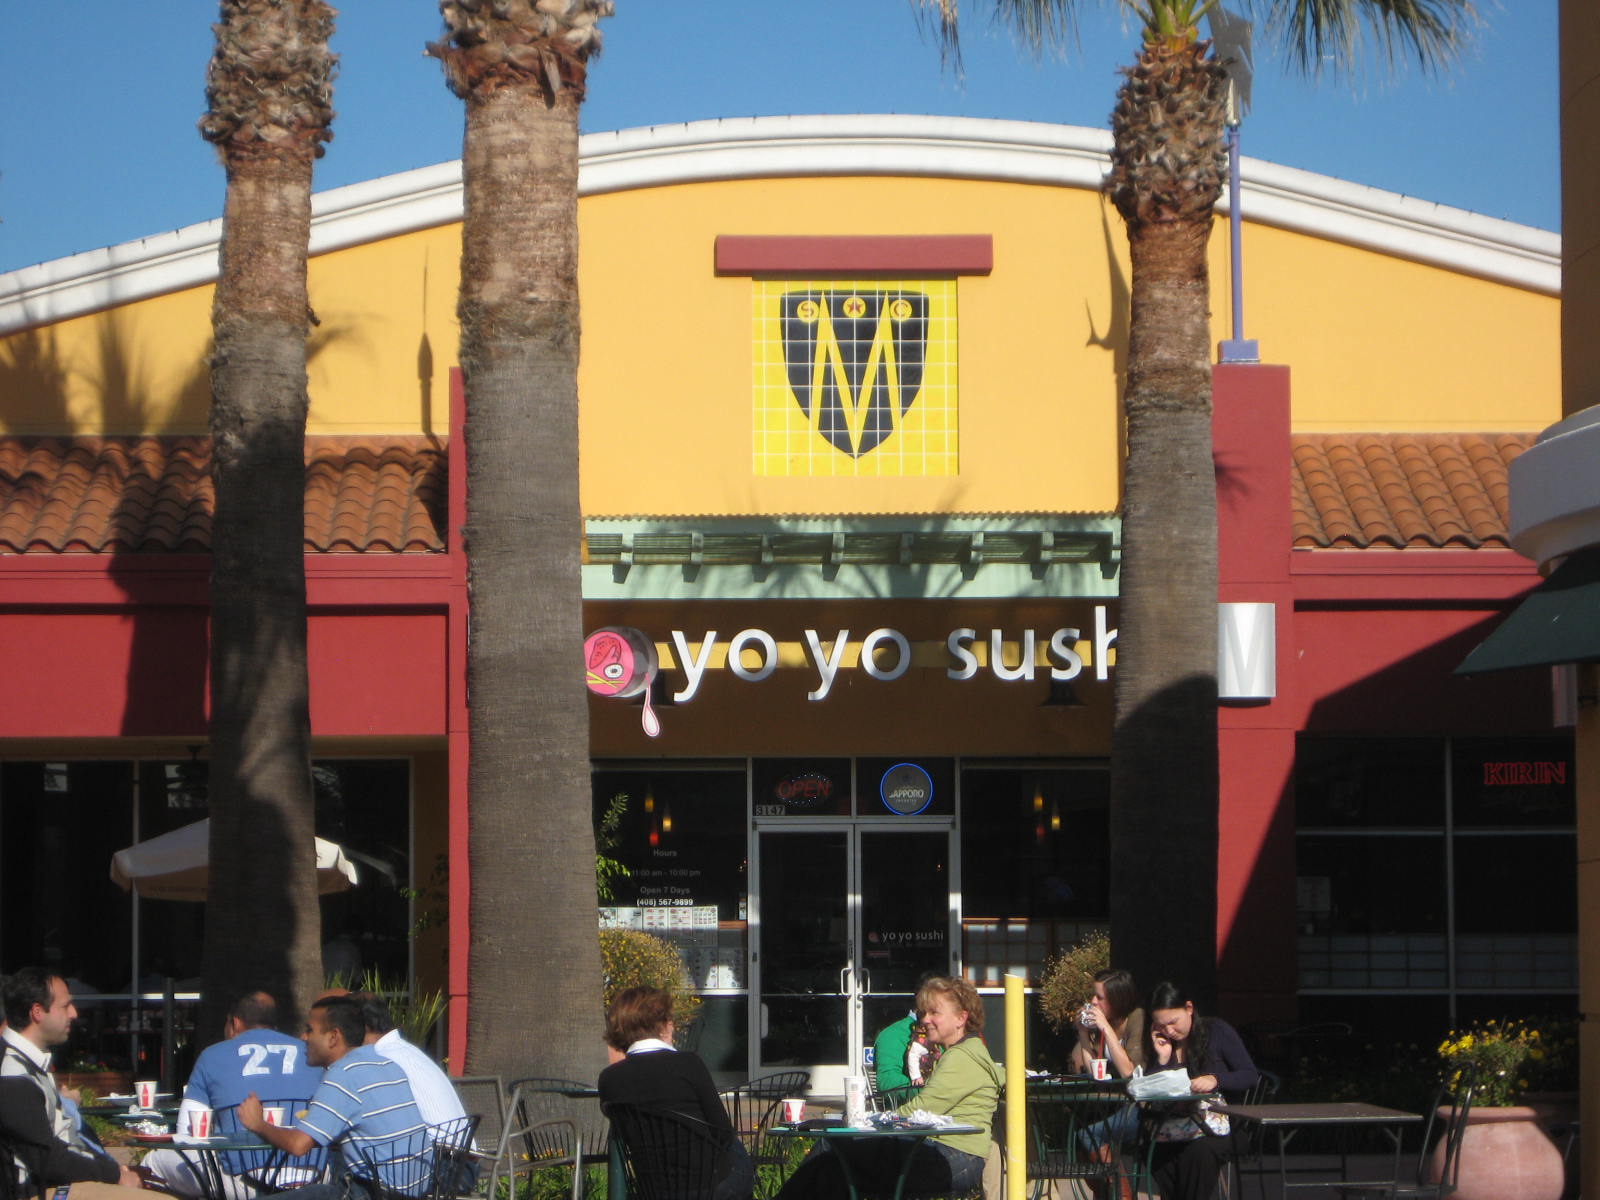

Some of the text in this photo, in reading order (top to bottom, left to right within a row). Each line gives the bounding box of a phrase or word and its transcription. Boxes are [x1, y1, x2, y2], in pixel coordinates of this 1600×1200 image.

[672, 605, 1118, 702] yo yo sush
[1483, 761, 1567, 785] KIRIN
[777, 779, 832, 799] OPEN
[653, 849, 677, 857] Hours
[640, 886, 690, 896] Open 7 Days
[882, 929, 944, 943] yo yo sushi
[238, 1044, 298, 1076] 27
